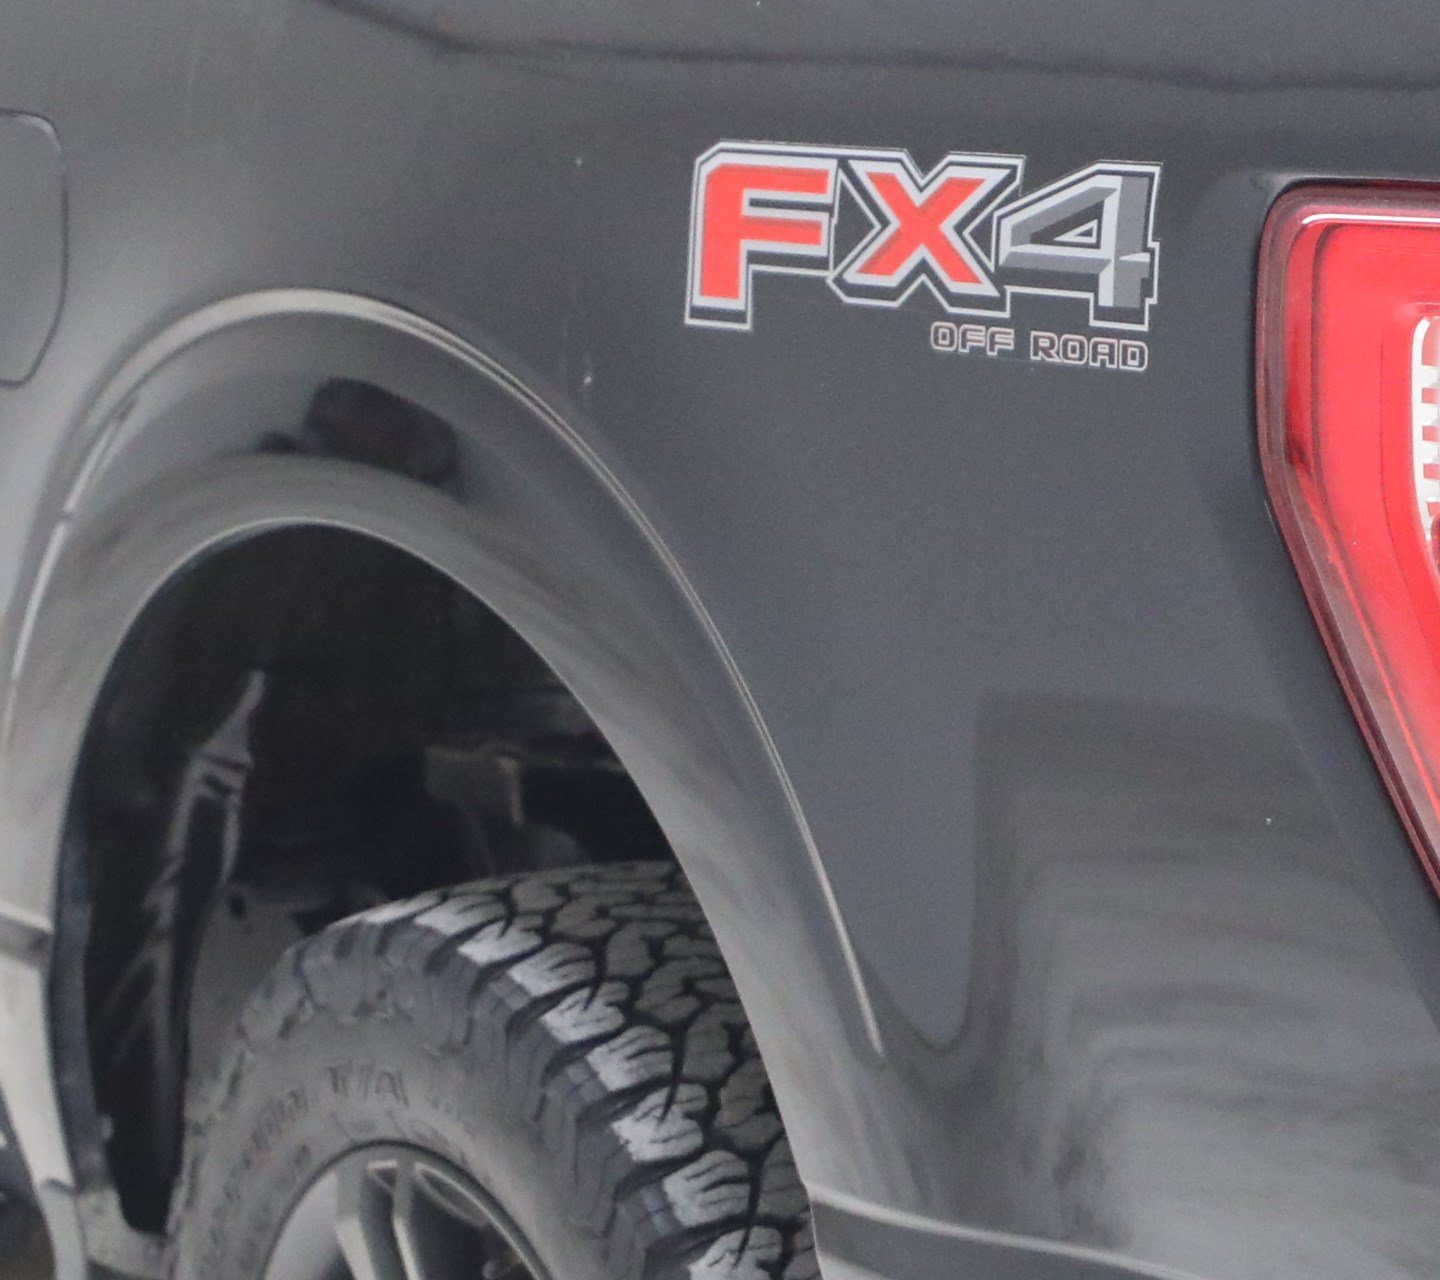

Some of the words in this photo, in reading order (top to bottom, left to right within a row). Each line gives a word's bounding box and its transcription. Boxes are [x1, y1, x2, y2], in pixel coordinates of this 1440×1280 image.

[685, 140, 1163, 332] FX4
[930, 321, 1014, 356] OFF
[1030, 330, 1149, 371] ROAD
